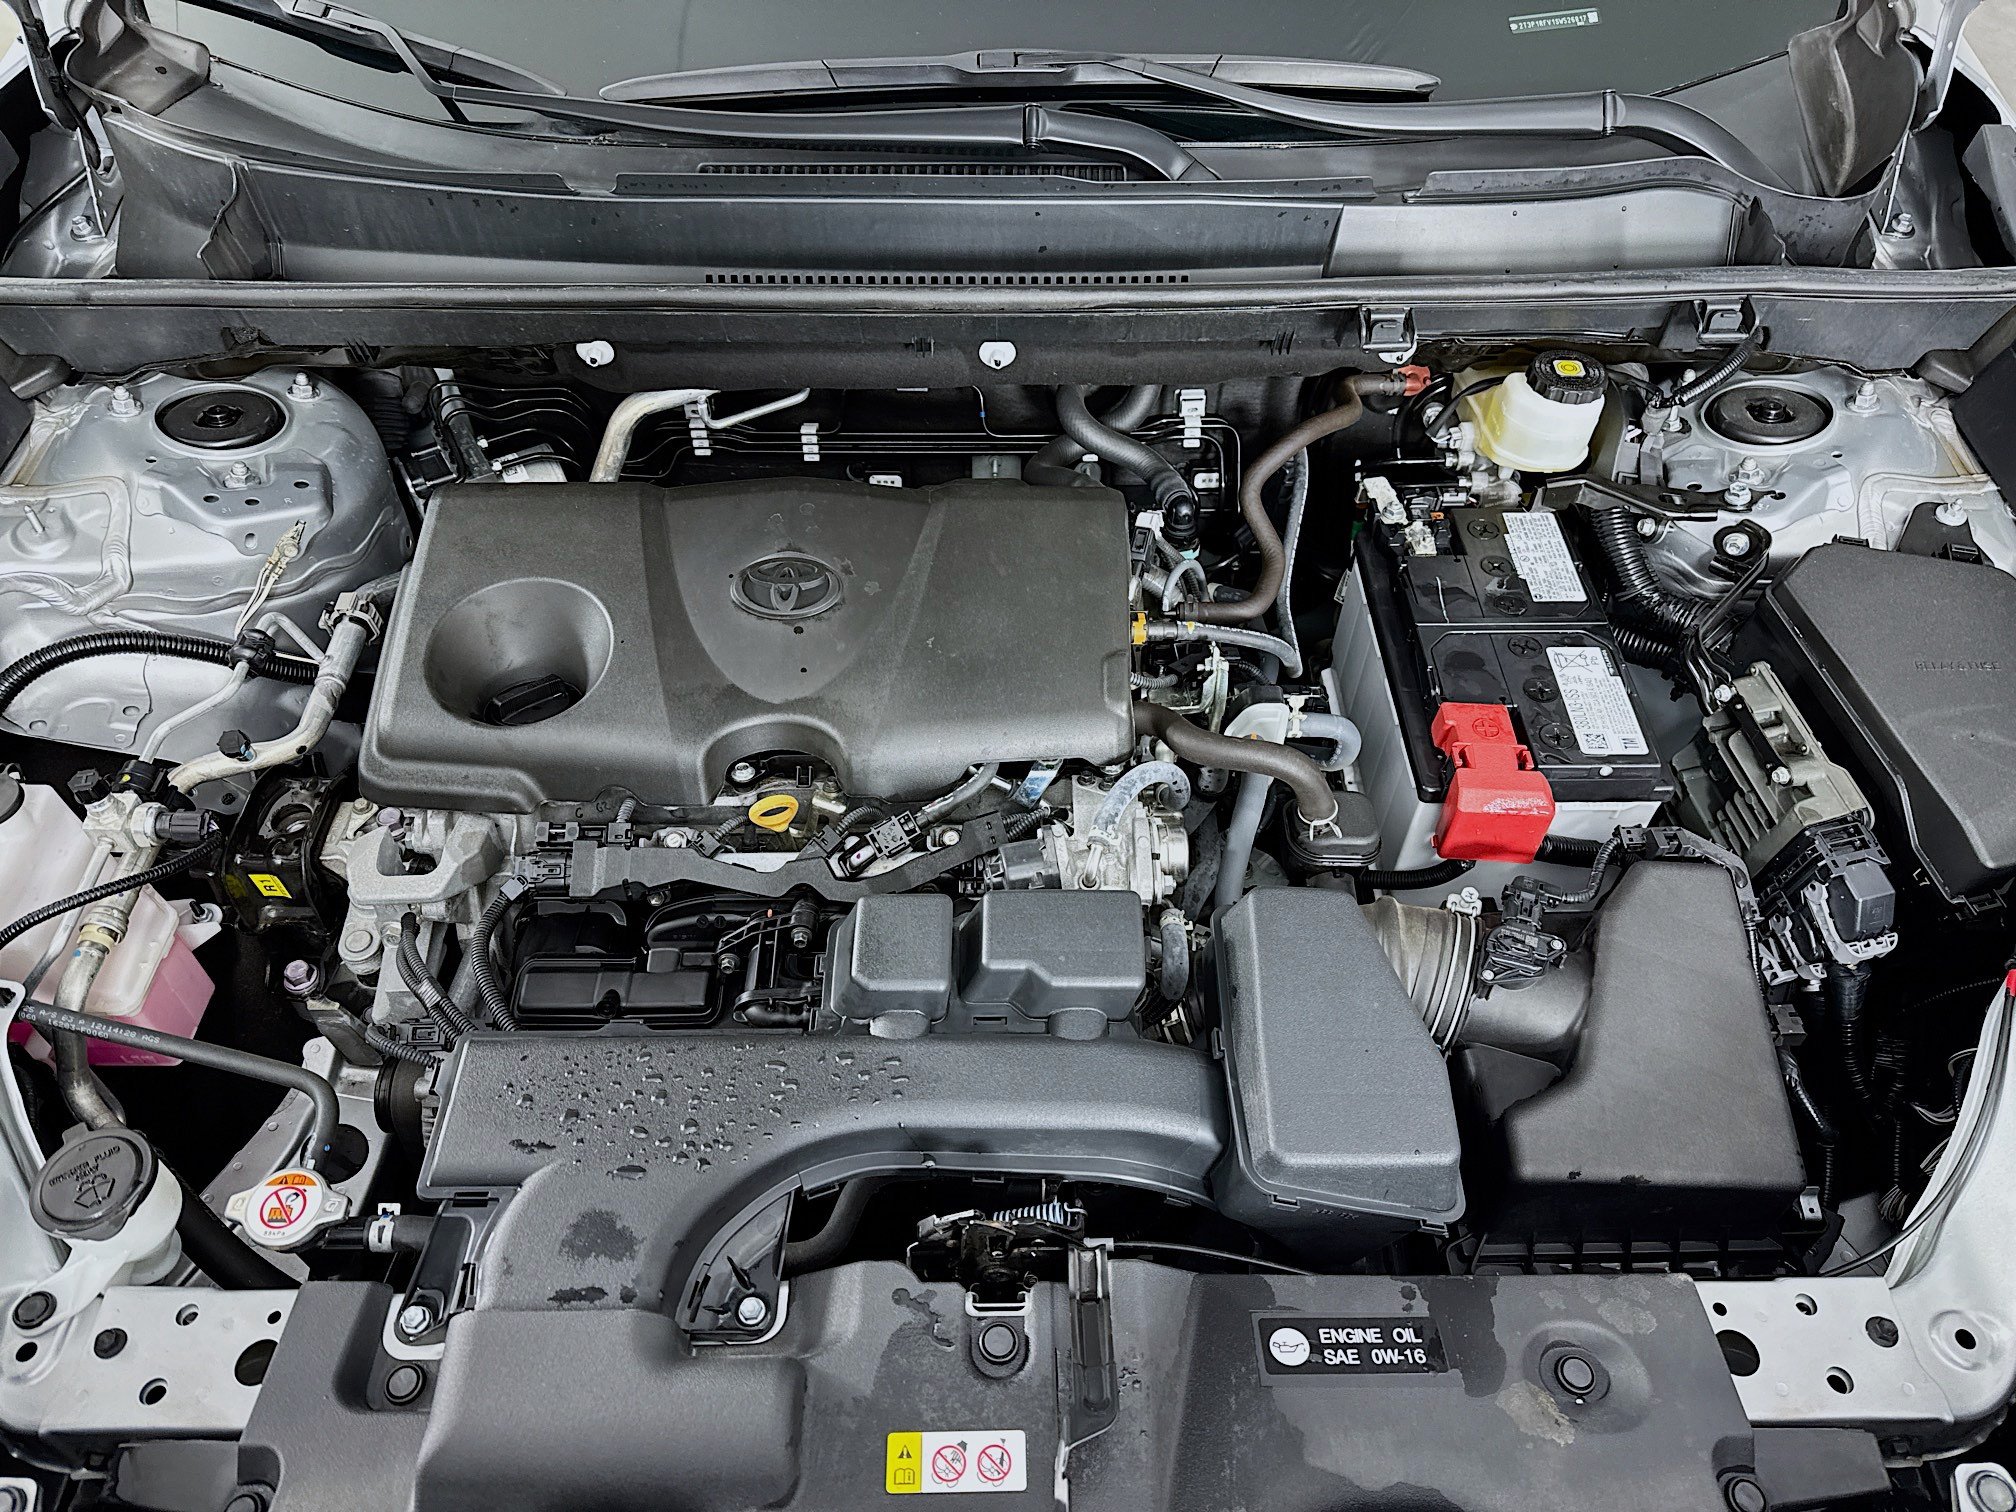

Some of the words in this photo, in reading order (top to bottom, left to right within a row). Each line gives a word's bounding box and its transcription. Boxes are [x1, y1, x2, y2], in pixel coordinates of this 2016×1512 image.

[1318, 1327, 1384, 1344] ENGINE
[1392, 1327, 1423, 1344] OIL
[1323, 1348, 1360, 1365] SAE
[1371, 1348, 1427, 1365] 0W-16
